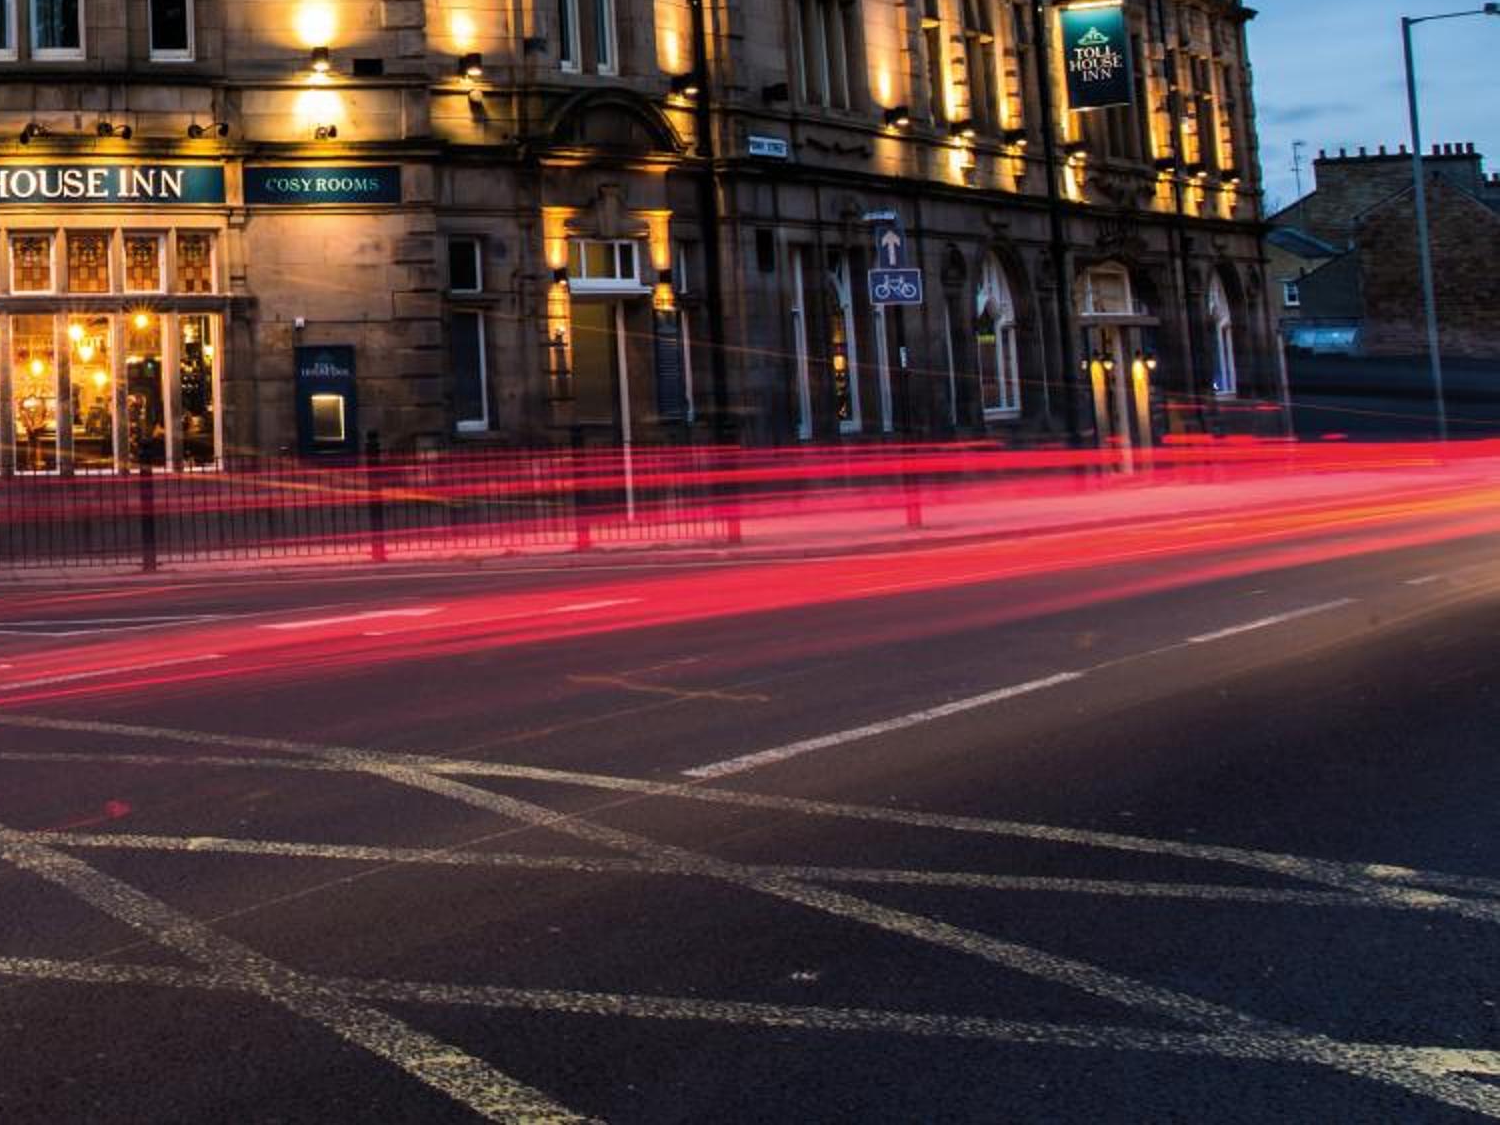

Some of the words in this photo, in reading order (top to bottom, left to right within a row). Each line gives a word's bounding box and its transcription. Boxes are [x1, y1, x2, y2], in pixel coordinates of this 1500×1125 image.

[1074, 45, 1116, 59] TOLL
[1069, 55, 1122, 72] HOUSE
[1083, 68, 1112, 82] INN
[117, 169, 184, 198] INN
[265, 178, 312, 192] COSY
[315, 178, 380, 192] ROOMS
